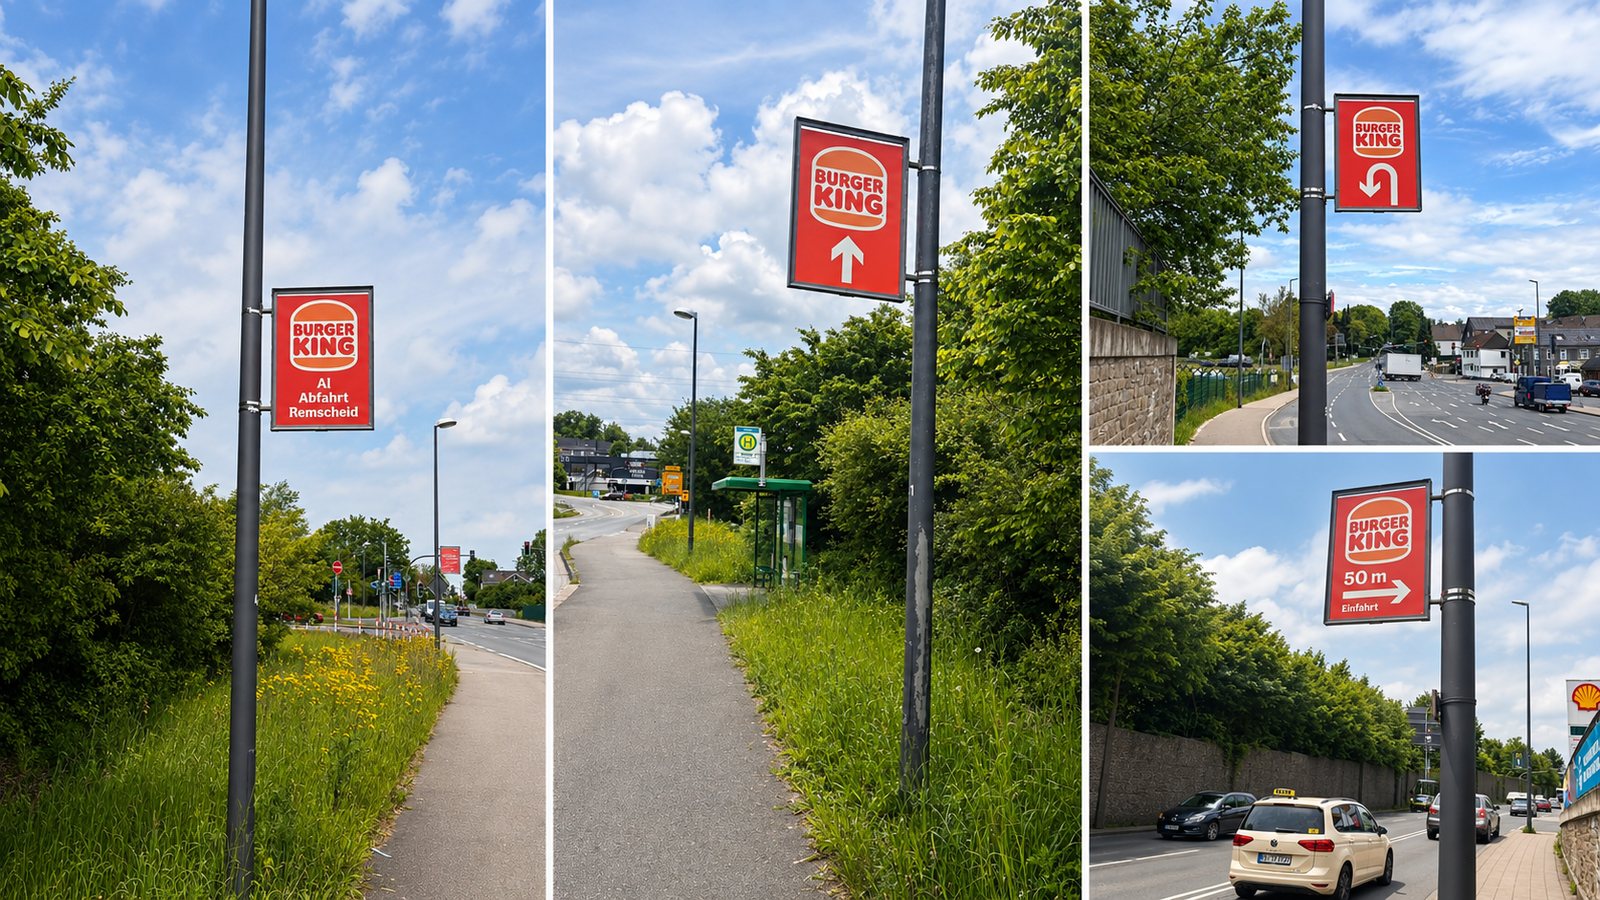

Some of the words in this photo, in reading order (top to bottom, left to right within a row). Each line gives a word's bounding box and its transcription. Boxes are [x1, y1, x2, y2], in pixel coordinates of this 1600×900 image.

[1355, 123, 1401, 133] BURGER
[1355, 133, 1401, 147] KING
[815, 168, 884, 195] BURGER
[814, 184, 883, 216] KING
[293, 323, 354, 336] BURGER
[293, 337, 354, 356] KING
[298, 391, 349, 403] Abfahrt
[289, 406, 359, 418] Remscheid
[1349, 515, 1409, 533] BURGER
[1348, 529, 1409, 551] KING
[1343, 570, 1368, 586] 50
[1371, 572, 1387, 584] m
[1341, 602, 1379, 613] Einfahrt
